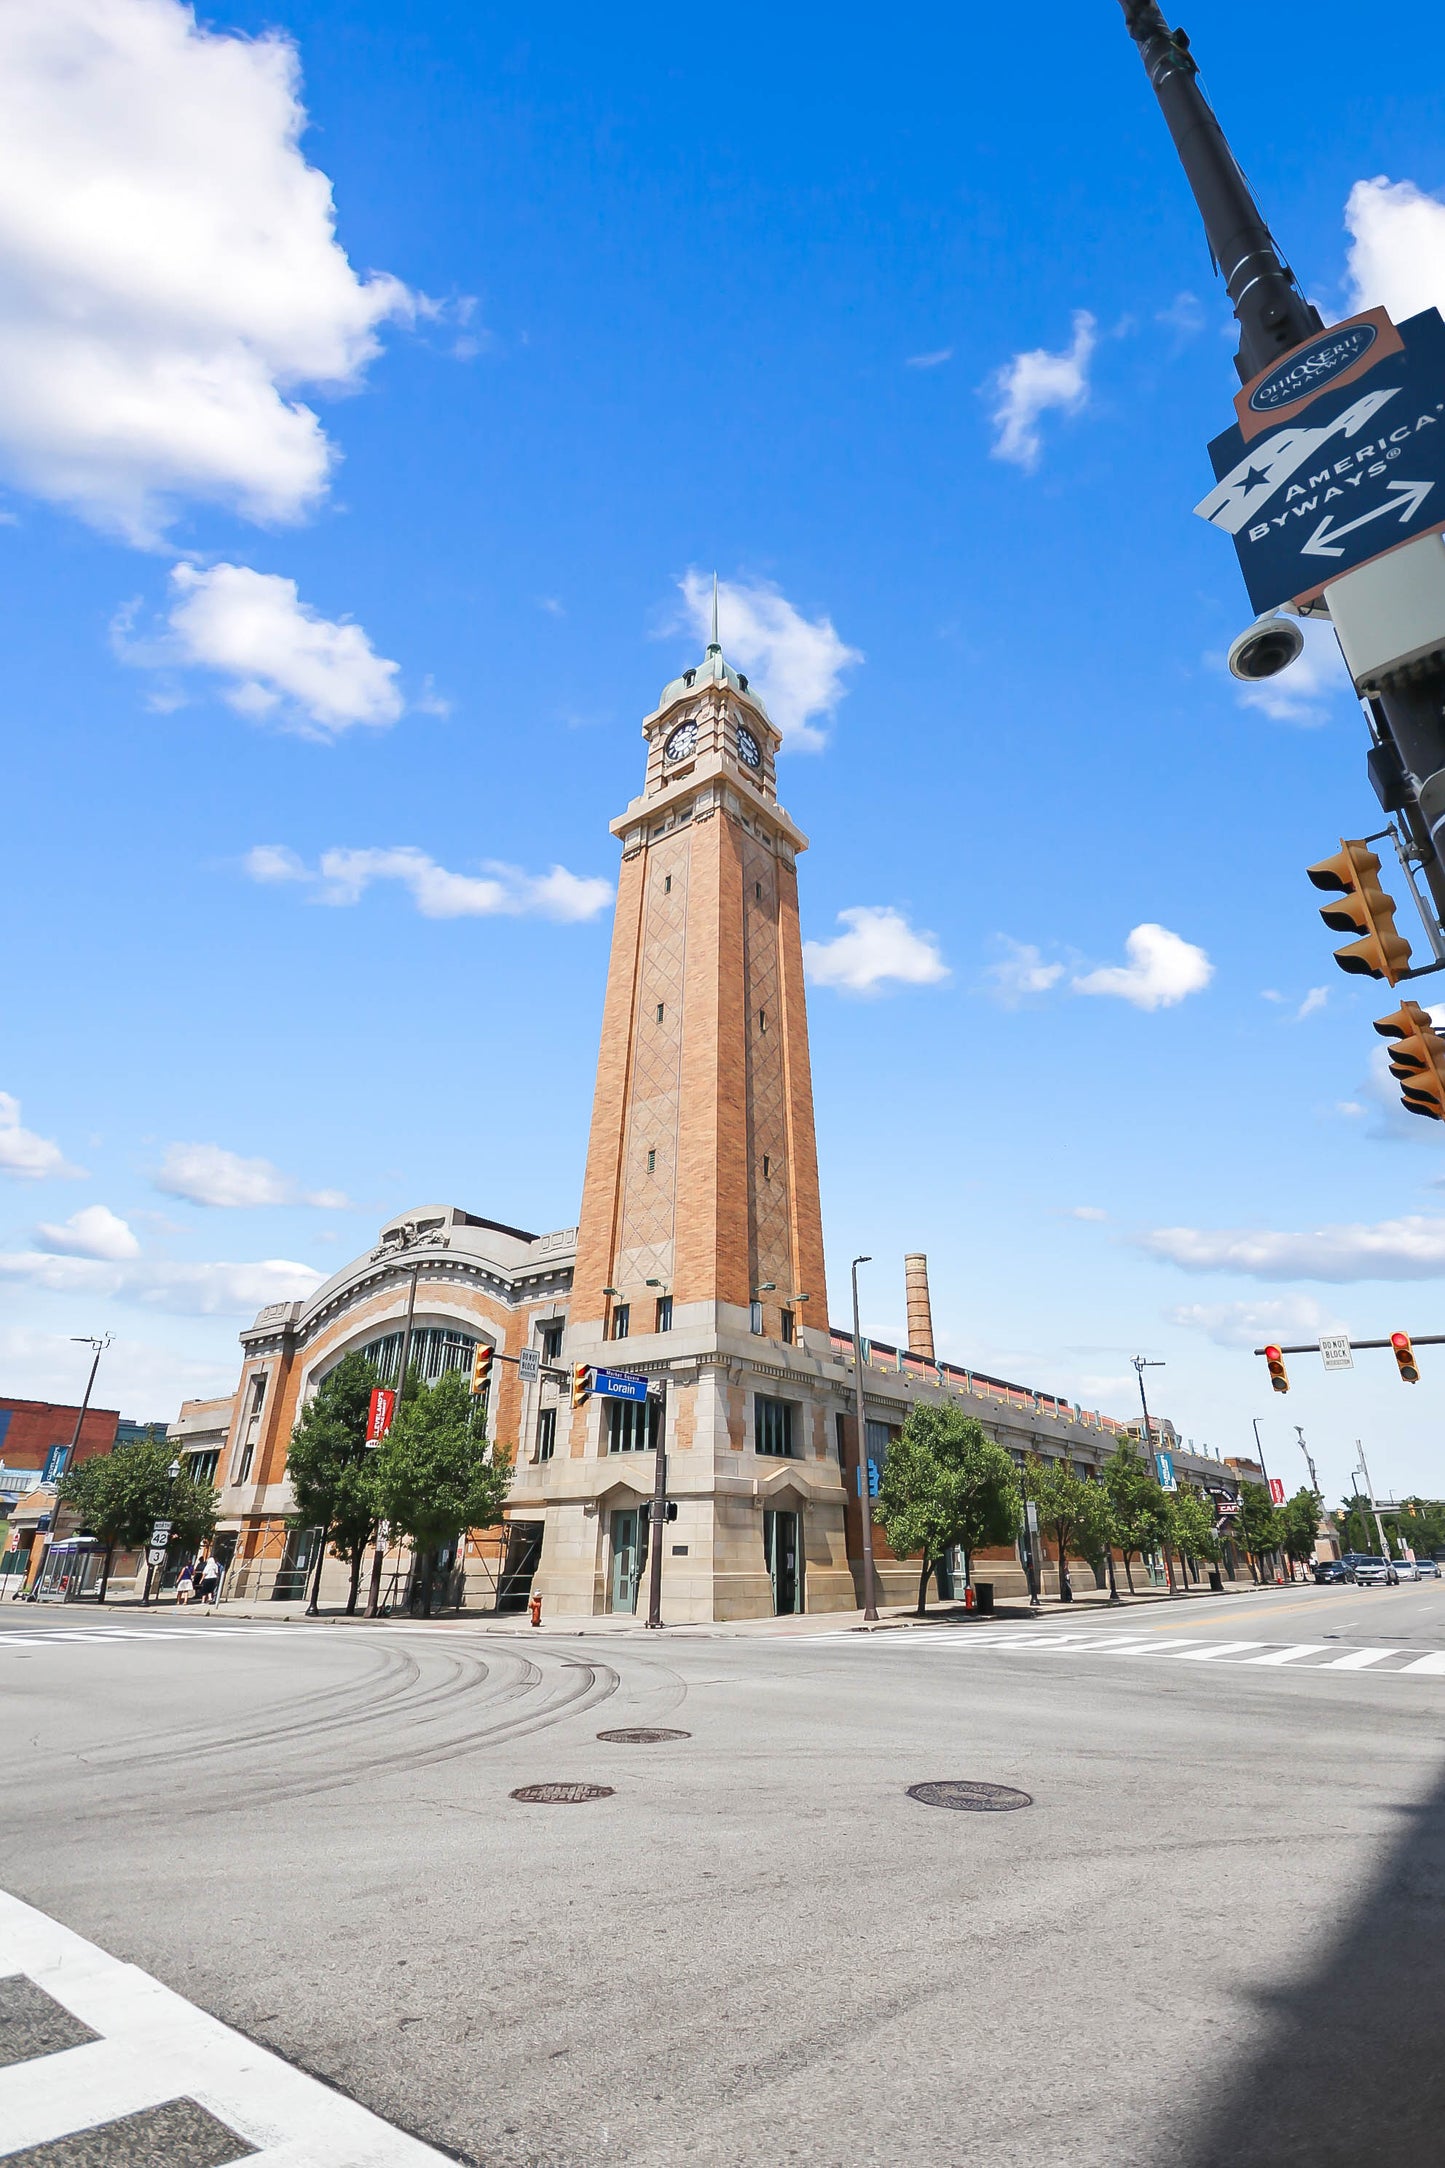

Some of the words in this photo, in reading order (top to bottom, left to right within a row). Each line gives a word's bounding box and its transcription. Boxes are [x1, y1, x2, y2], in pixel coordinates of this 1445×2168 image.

[1270, 345, 1360, 402] CANALWAY
[1322, 1341, 1331, 1349] DO
[1332, 1340, 1345, 1348] NOT
[522, 1352, 529, 1360] DO
[1325, 1349, 1347, 1358] BLOCK
[522, 1361, 536, 1370] BLOCK
[608, 1379, 635, 1395] Lorain
[153, 1533, 166, 1543] 42
[153, 1552, 160, 1561] 3
